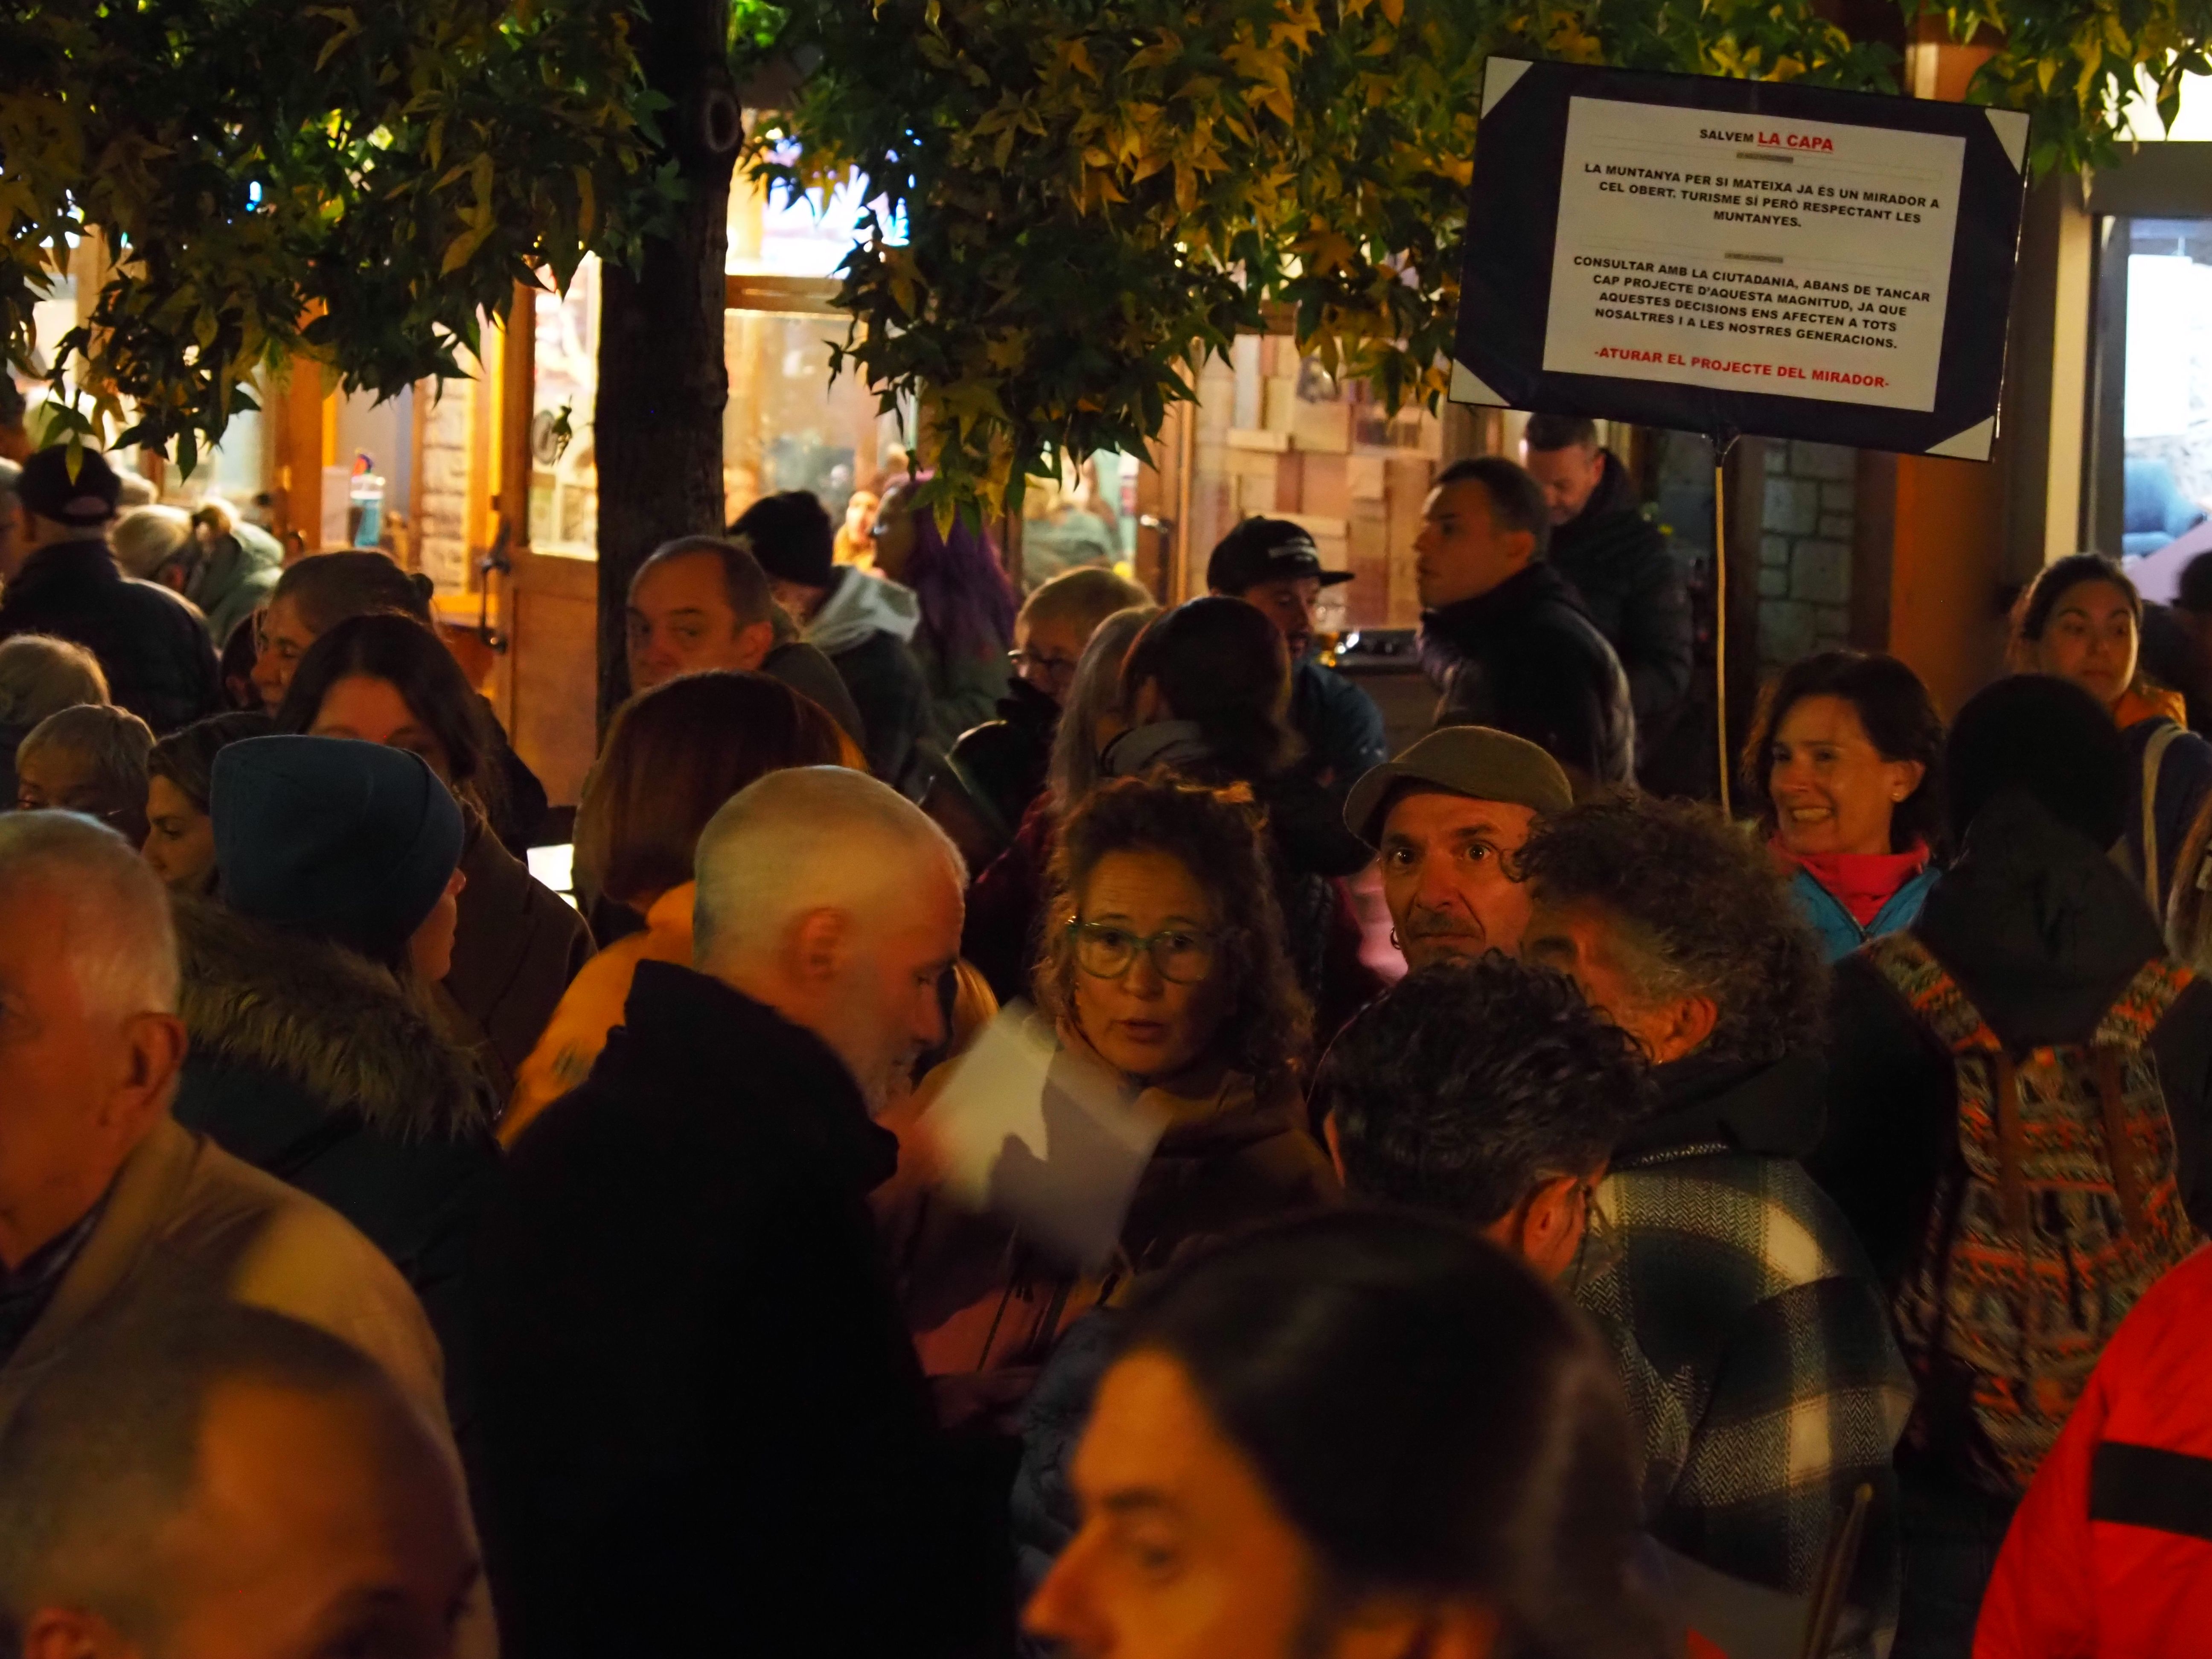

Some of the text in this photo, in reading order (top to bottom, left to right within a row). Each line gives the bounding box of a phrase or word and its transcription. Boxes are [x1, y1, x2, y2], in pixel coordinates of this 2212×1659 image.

[1700, 129, 1834, 151] SALVEM LA CAPA
[1584, 163, 1601, 174] LA
[1606, 165, 1680, 182] MUNTANYA
[1685, 174, 1711, 185] PER
[1715, 177, 1729, 187] SI
[1733, 178, 1793, 192] MATEIXA
[1796, 184, 1813, 195] JA
[1839, 188, 1859, 200] UN
[1863, 191, 1926, 207] MIRADOR
[1930, 199, 1939, 209] A
[1599, 181, 1624, 193] CEL
[1629, 184, 1676, 198] OBERT.
[1681, 190, 1740, 205] TURISME
[1803, 201, 1892, 220] RESPECTANT
[1896, 212, 1921, 224] LES
[1714, 210, 1802, 227] MUNTANYES.
[1574, 256, 1930, 302] CONSULTAR AMB LA CIUTADANIA, ABANS DE TANCAR
[1593, 274, 1906, 316] CAP PROJECTE D'AQUESTA MAGNITUD, JA QUE
[1595, 308, 1897, 349] NOSALTRES I A LES NOSTRES GENERACIONS.
[1599, 292, 1897, 332] AQUESTES DECISIONS ENS AFECTEN A TOTS
[1595, 347, 1889, 388] -ATURAR EL PROJECTE DEL MIRADOR-
